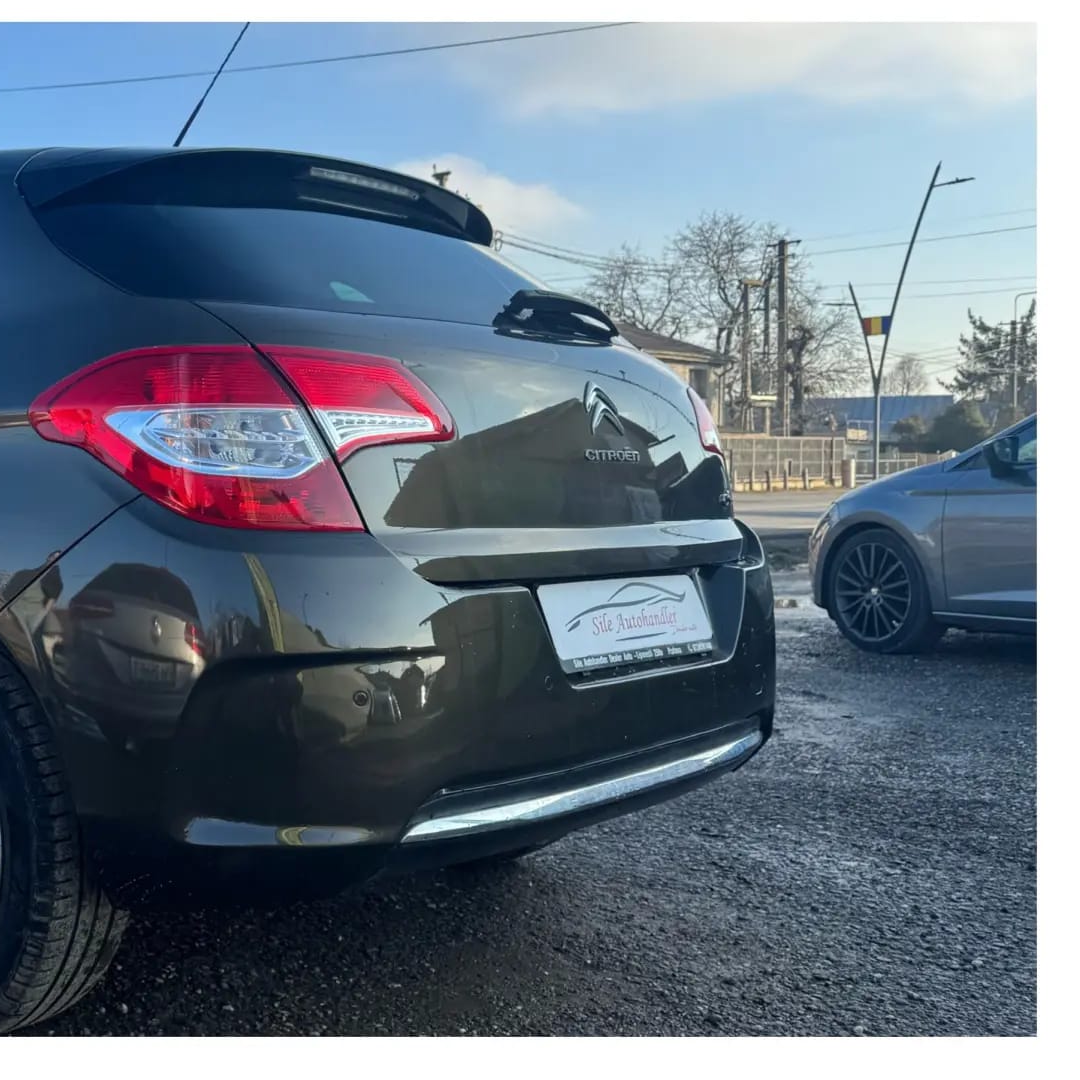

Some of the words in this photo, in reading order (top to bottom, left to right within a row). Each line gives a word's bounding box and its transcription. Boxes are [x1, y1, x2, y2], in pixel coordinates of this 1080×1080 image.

[585, 447, 640, 462] CITROËN
[592, 612, 613, 636] Sile
[616, 607, 677, 633] Autohandler
